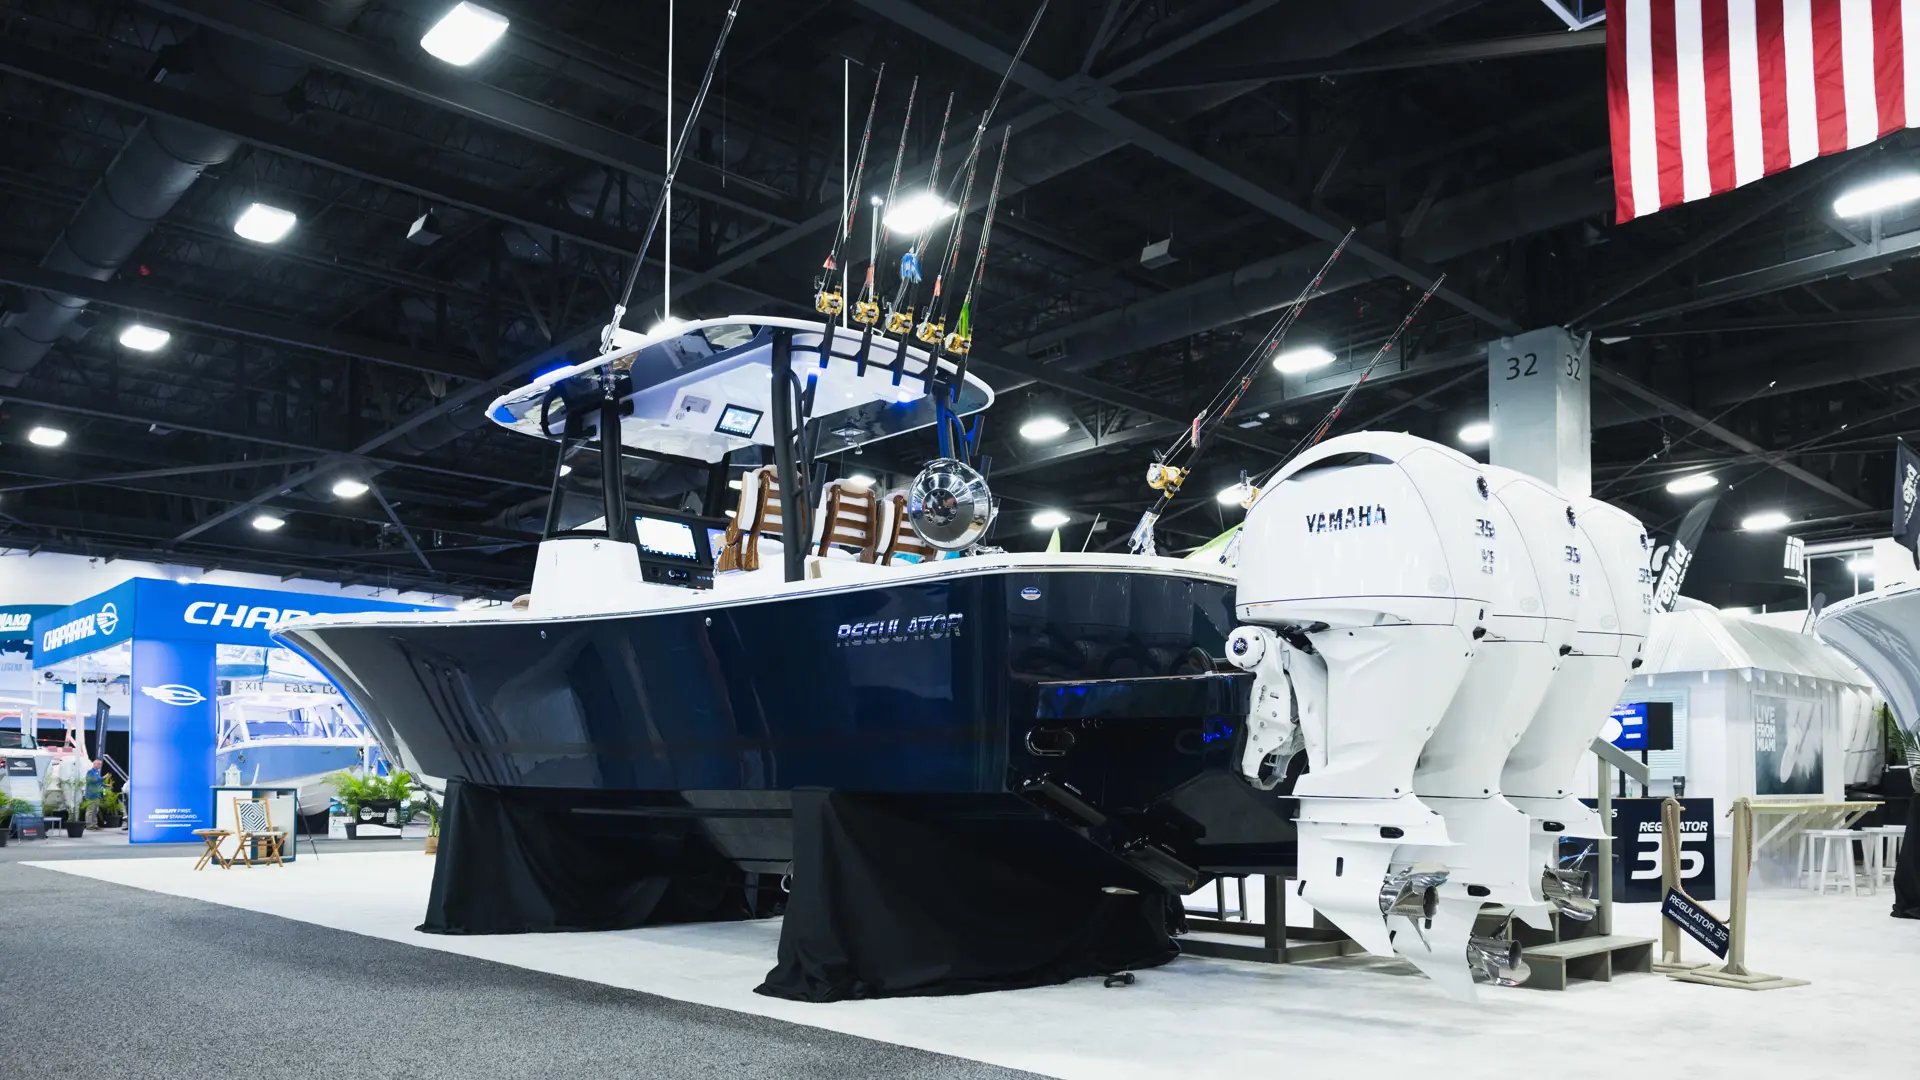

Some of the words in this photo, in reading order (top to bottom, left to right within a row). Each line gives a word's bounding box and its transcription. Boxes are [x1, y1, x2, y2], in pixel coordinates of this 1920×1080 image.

[1506, 353, 1538, 381] 32
[1566, 354, 1581, 381] 32
[1306, 504, 1387, 534] YAMAHA
[184, 601, 312, 630] CHAP
[836, 613, 963, 647] REGULATOR
[43, 613, 97, 652] CHAPARRAL
[1756, 704, 1776, 724] LIVE
[1756, 723, 1776, 738] FROM
[1757, 738, 1777, 752] MIAMI
[1639, 821, 1708, 832] REGATOR
[1631, 833, 1708, 879] 35
[1668, 908, 1690, 928] BOARDING
[1689, 924, 1705, 939] BEGINS
[1669, 894, 1716, 932] REGULATOR
[1714, 928, 1729, 942] 35
